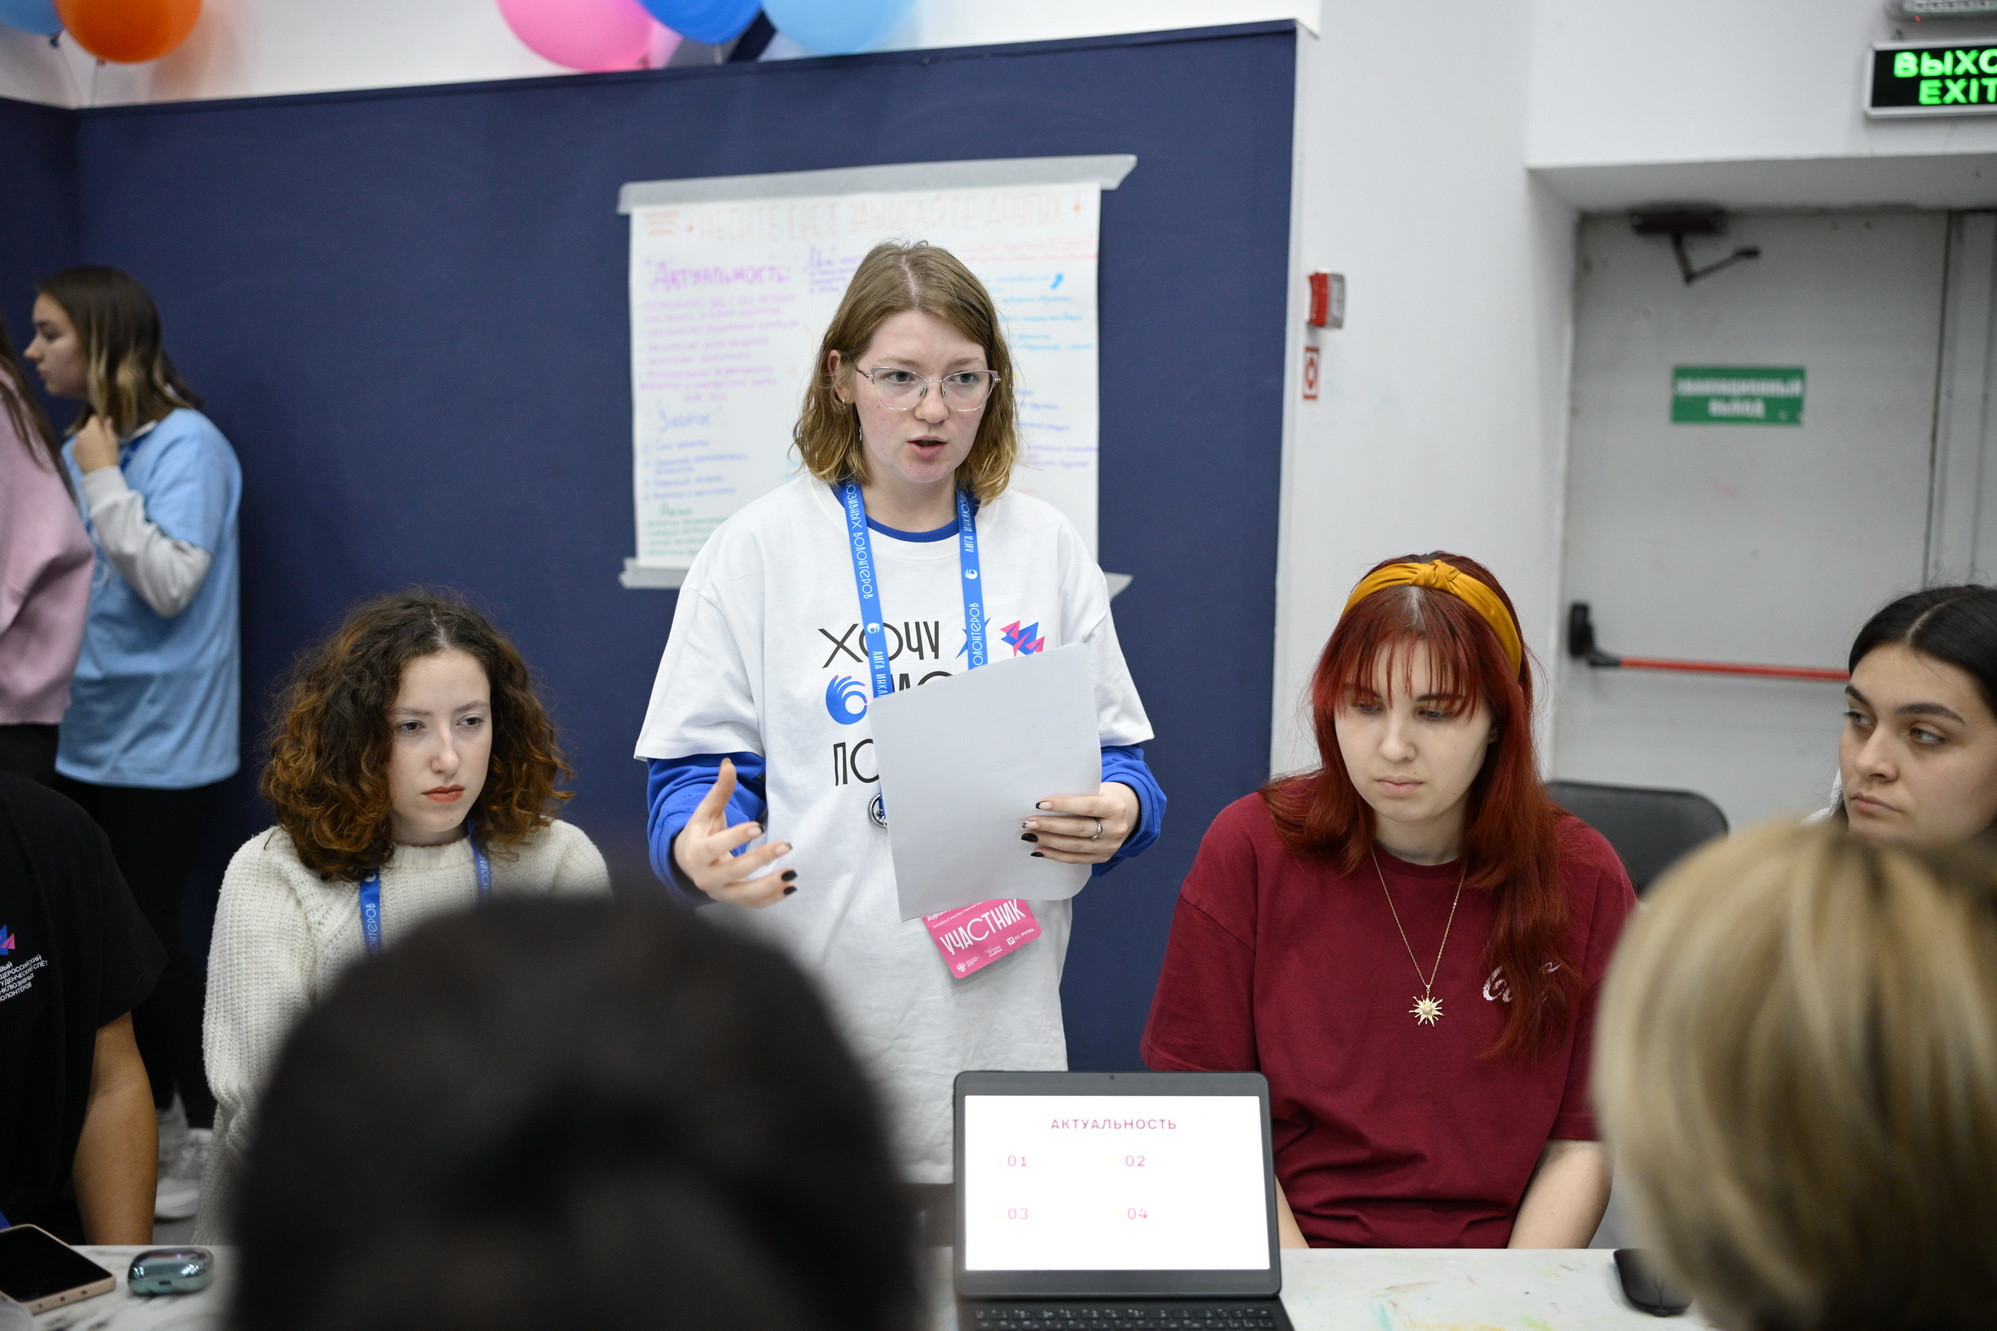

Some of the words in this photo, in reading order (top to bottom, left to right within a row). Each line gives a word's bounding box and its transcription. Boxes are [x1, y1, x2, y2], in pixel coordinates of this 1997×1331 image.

[1894, 48, 1997, 78] ВЫХО
[1918, 77, 1997, 105] EXIT
[964, 535, 975, 553] ЛИГА
[969, 602, 984, 666] ОЛОНТЕРОВ
[873, 651, 885, 669] ЛИГА
[876, 673, 888, 697] ИНКЛ
[365, 902, 379, 953] ОНТЕРОВ
[940, 899, 1026, 955] УЧАСТНИК
[1051, 1118, 1177, 1130] АКТУАЛЬНОСТЬ
[1007, 1155, 1028, 1167] 01
[1125, 1155, 1146, 1167] 02
[1007, 1207, 1029, 1220] 03
[1127, 1207, 1148, 1220] 04
